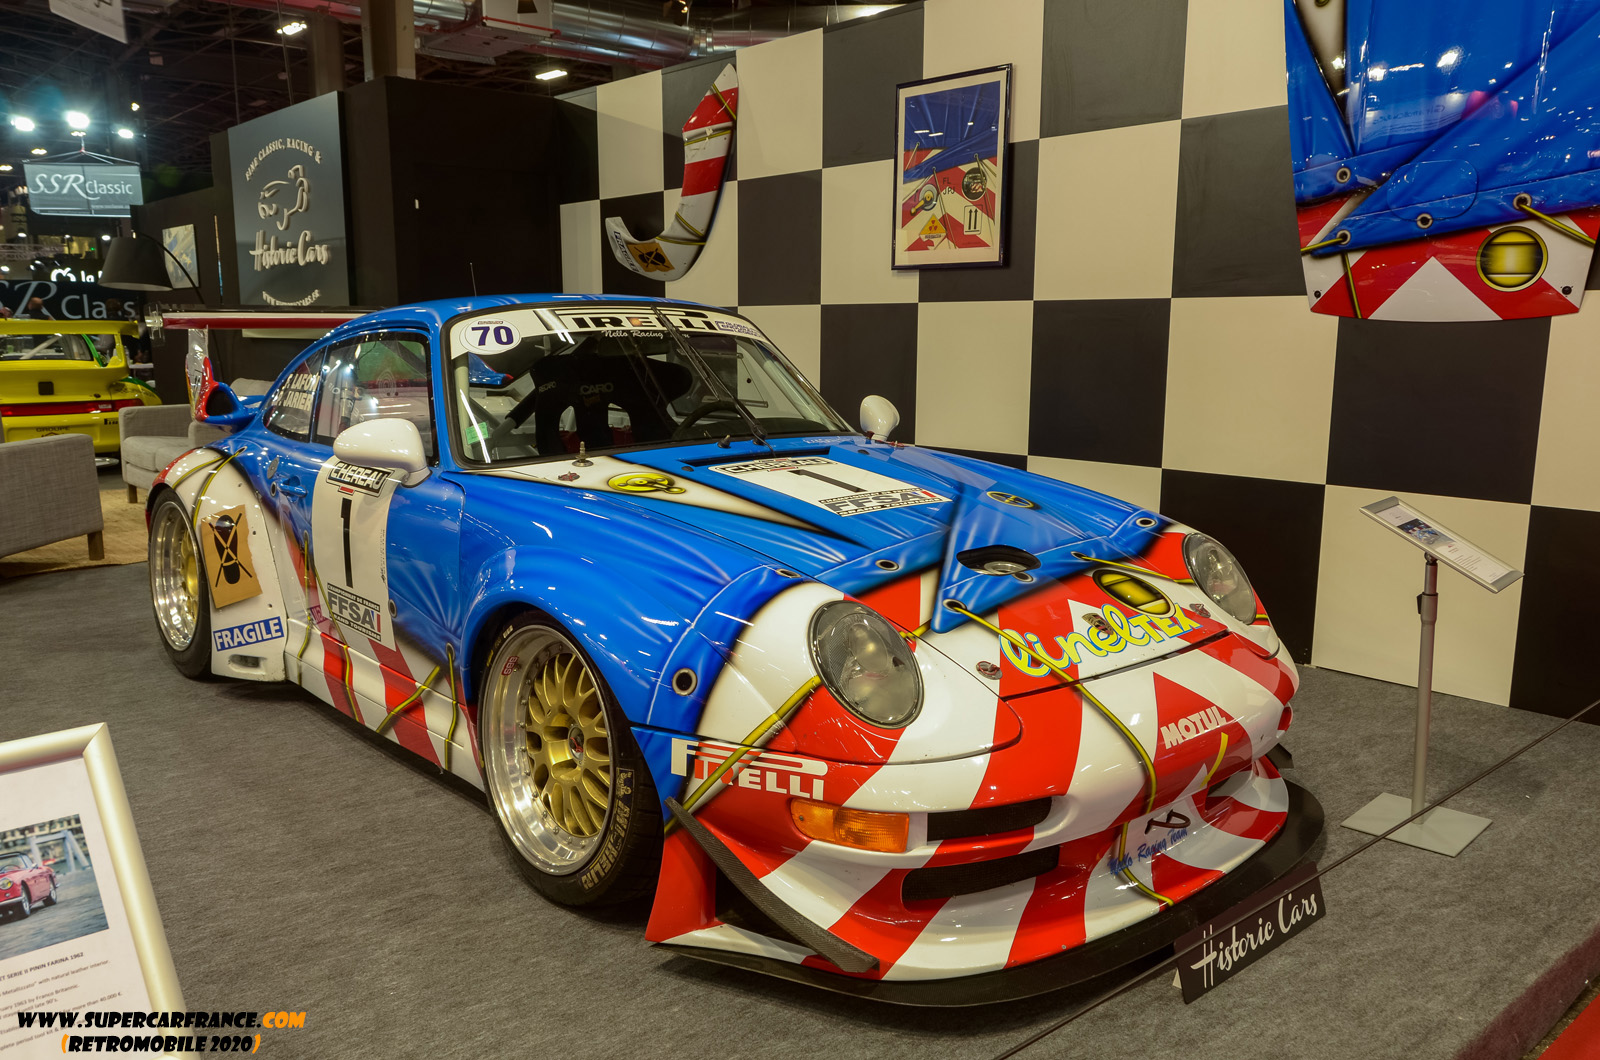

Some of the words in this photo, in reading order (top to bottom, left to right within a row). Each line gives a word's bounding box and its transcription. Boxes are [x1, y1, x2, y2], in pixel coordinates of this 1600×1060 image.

[286, 138, 314, 157] RACING
[314, 151, 323, 165] &
[29, 173, 100, 201] SSR
[85, 179, 134, 196] Classic
[249, 230, 298, 271] Historic
[297, 230, 331, 266] Cars
[471, 325, 514, 347] 70
[601, 329, 629, 338] Nello
[631, 329, 664, 340] Racing
[330, 461, 388, 491] CHEREAU
[787, 469, 868, 493] 1
[824, 491, 925, 512] FFSA
[340, 497, 354, 589] 1
[328, 591, 376, 631] FFSA
[213, 617, 283, 651] FRAGILE
[1159, 705, 1228, 750] MOTUL
[670, 737, 829, 801] PIRELLI
[580, 799, 631, 891] MICHELIN
[1137, 838, 1168, 863] Racing
[1167, 826, 1189, 846] Team
[1189, 923, 1275, 989] Historic
[1277, 892, 1318, 935] Cars
[6, 970, 24, 980] SERIE
[29, 963, 47, 973] PININ
[47, 956, 70, 967] FARINA
[70, 951, 84, 960] 1962
